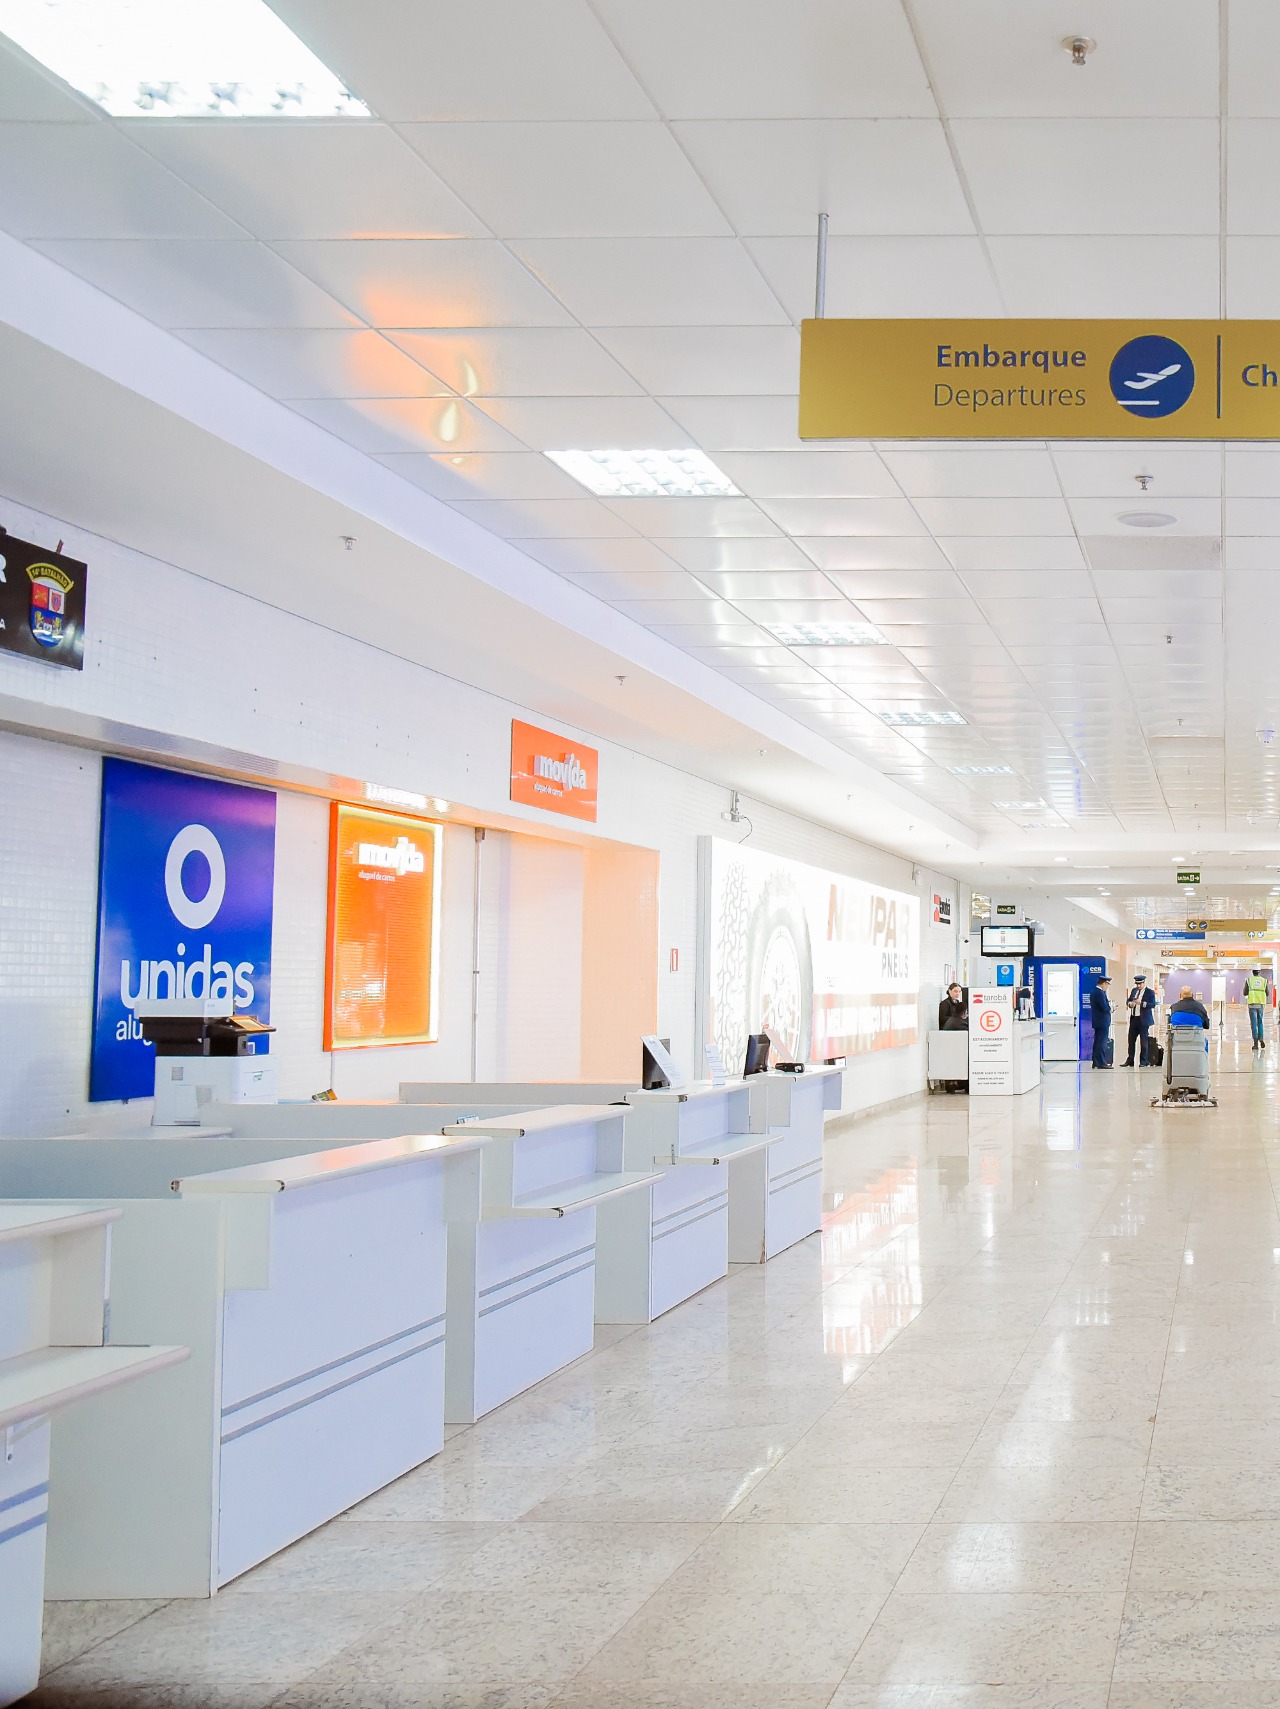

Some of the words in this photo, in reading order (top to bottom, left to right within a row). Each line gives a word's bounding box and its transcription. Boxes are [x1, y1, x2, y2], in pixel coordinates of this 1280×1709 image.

[937, 344, 1087, 373] Embarque
[934, 383, 1086, 412] Departures
[534, 753, 587, 791] movida
[120, 943, 255, 1009] unidas
[986, 1015, 995, 1027] E
